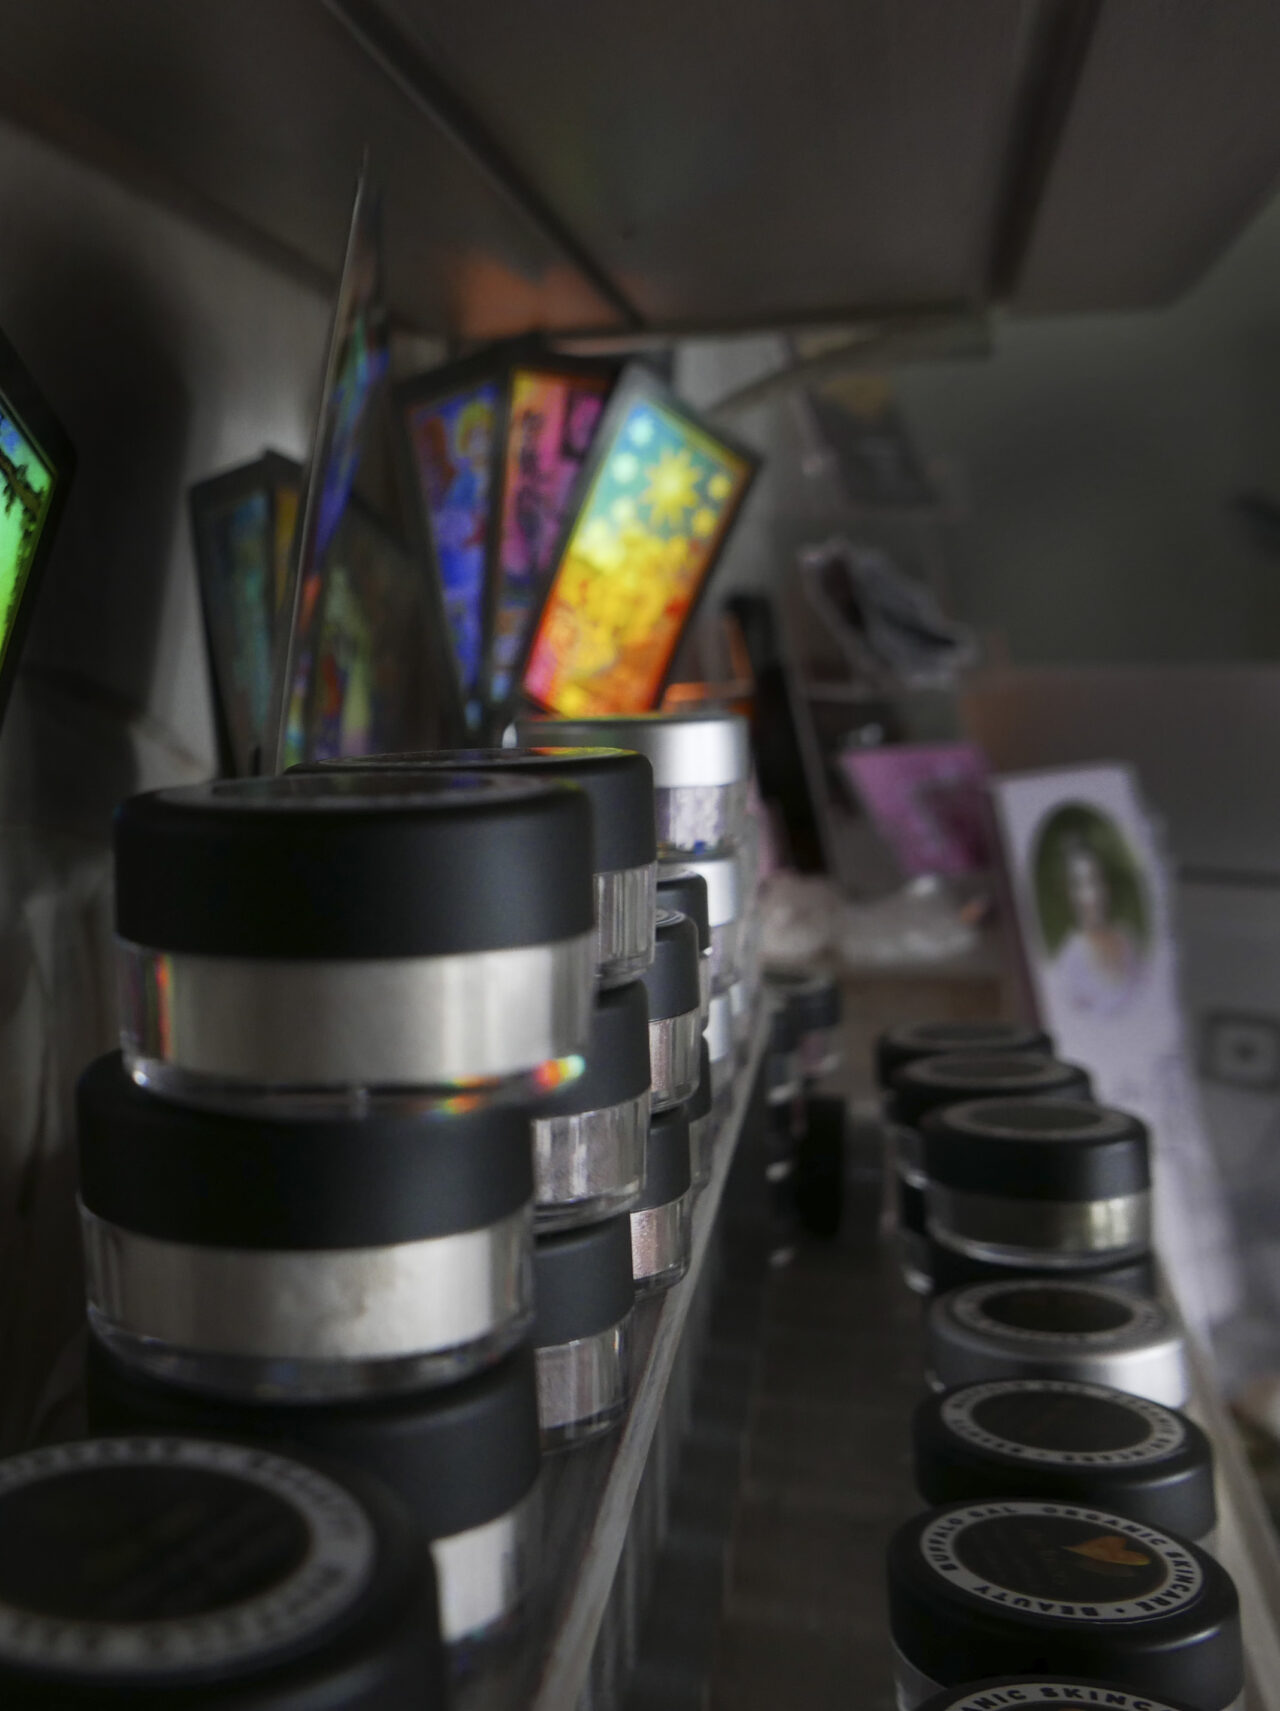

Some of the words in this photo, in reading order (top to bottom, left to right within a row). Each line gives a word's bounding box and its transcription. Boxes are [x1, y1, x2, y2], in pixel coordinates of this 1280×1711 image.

[1042, 1505, 1168, 1547] ORGANIC
[1135, 1551, 1195, 1612] SKINCARE
[973, 1585, 1100, 1617] BEAUTY
